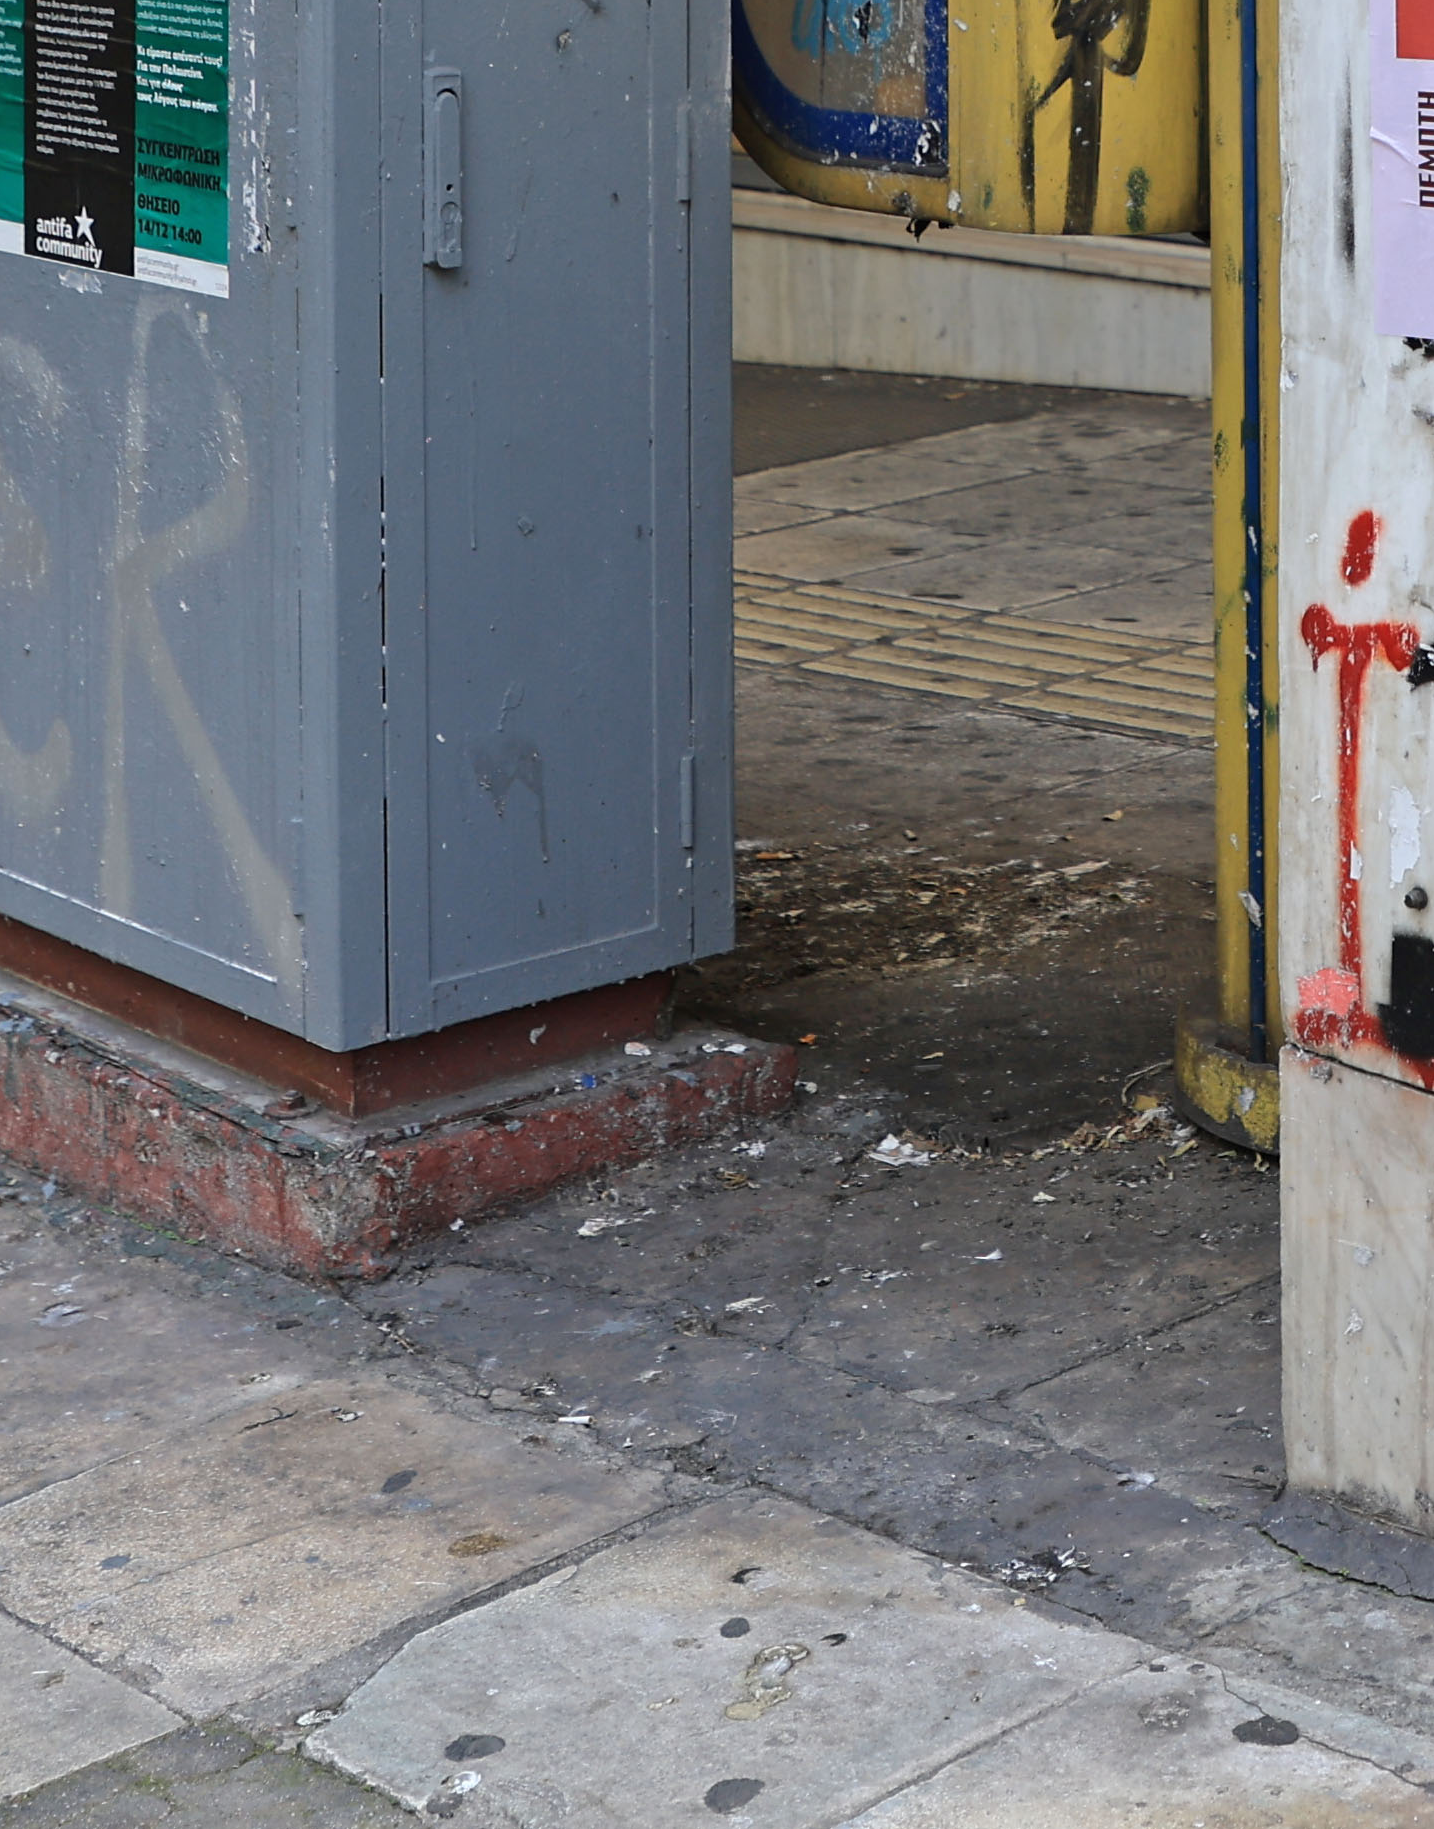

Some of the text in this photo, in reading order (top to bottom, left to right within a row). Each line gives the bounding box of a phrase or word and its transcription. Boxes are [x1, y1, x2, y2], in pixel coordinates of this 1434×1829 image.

[137, 137, 220, 167] ΣΥΓΚΕΝΤΡΩΣΗ
[137, 162, 222, 192] ΜΙΚΡΟΦΩΝΙΚΗ
[137, 194, 181, 216] ΘΗΣΕΙΟ
[36, 216, 73, 240] antifa
[137, 218, 202, 245] 14/12 14:00
[35, 236, 103, 269] community
